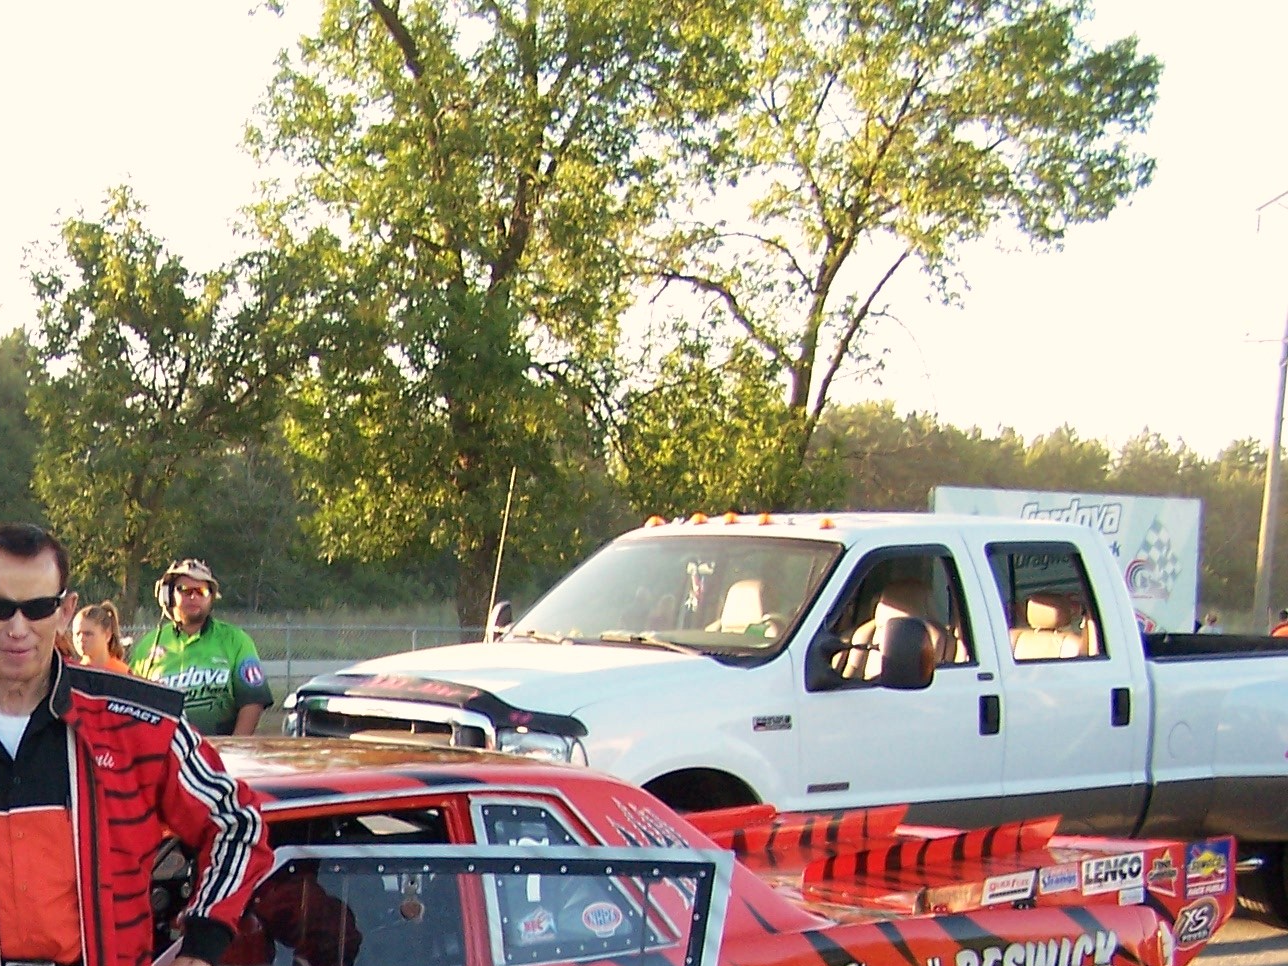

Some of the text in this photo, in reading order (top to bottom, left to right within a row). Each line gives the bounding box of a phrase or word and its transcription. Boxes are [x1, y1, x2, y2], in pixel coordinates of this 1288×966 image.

[158, 666, 230, 688] ordova
[108, 703, 160, 724] IMPACT
[1084, 856, 1142, 885] LENCO
[1180, 906, 1209, 934] XS
